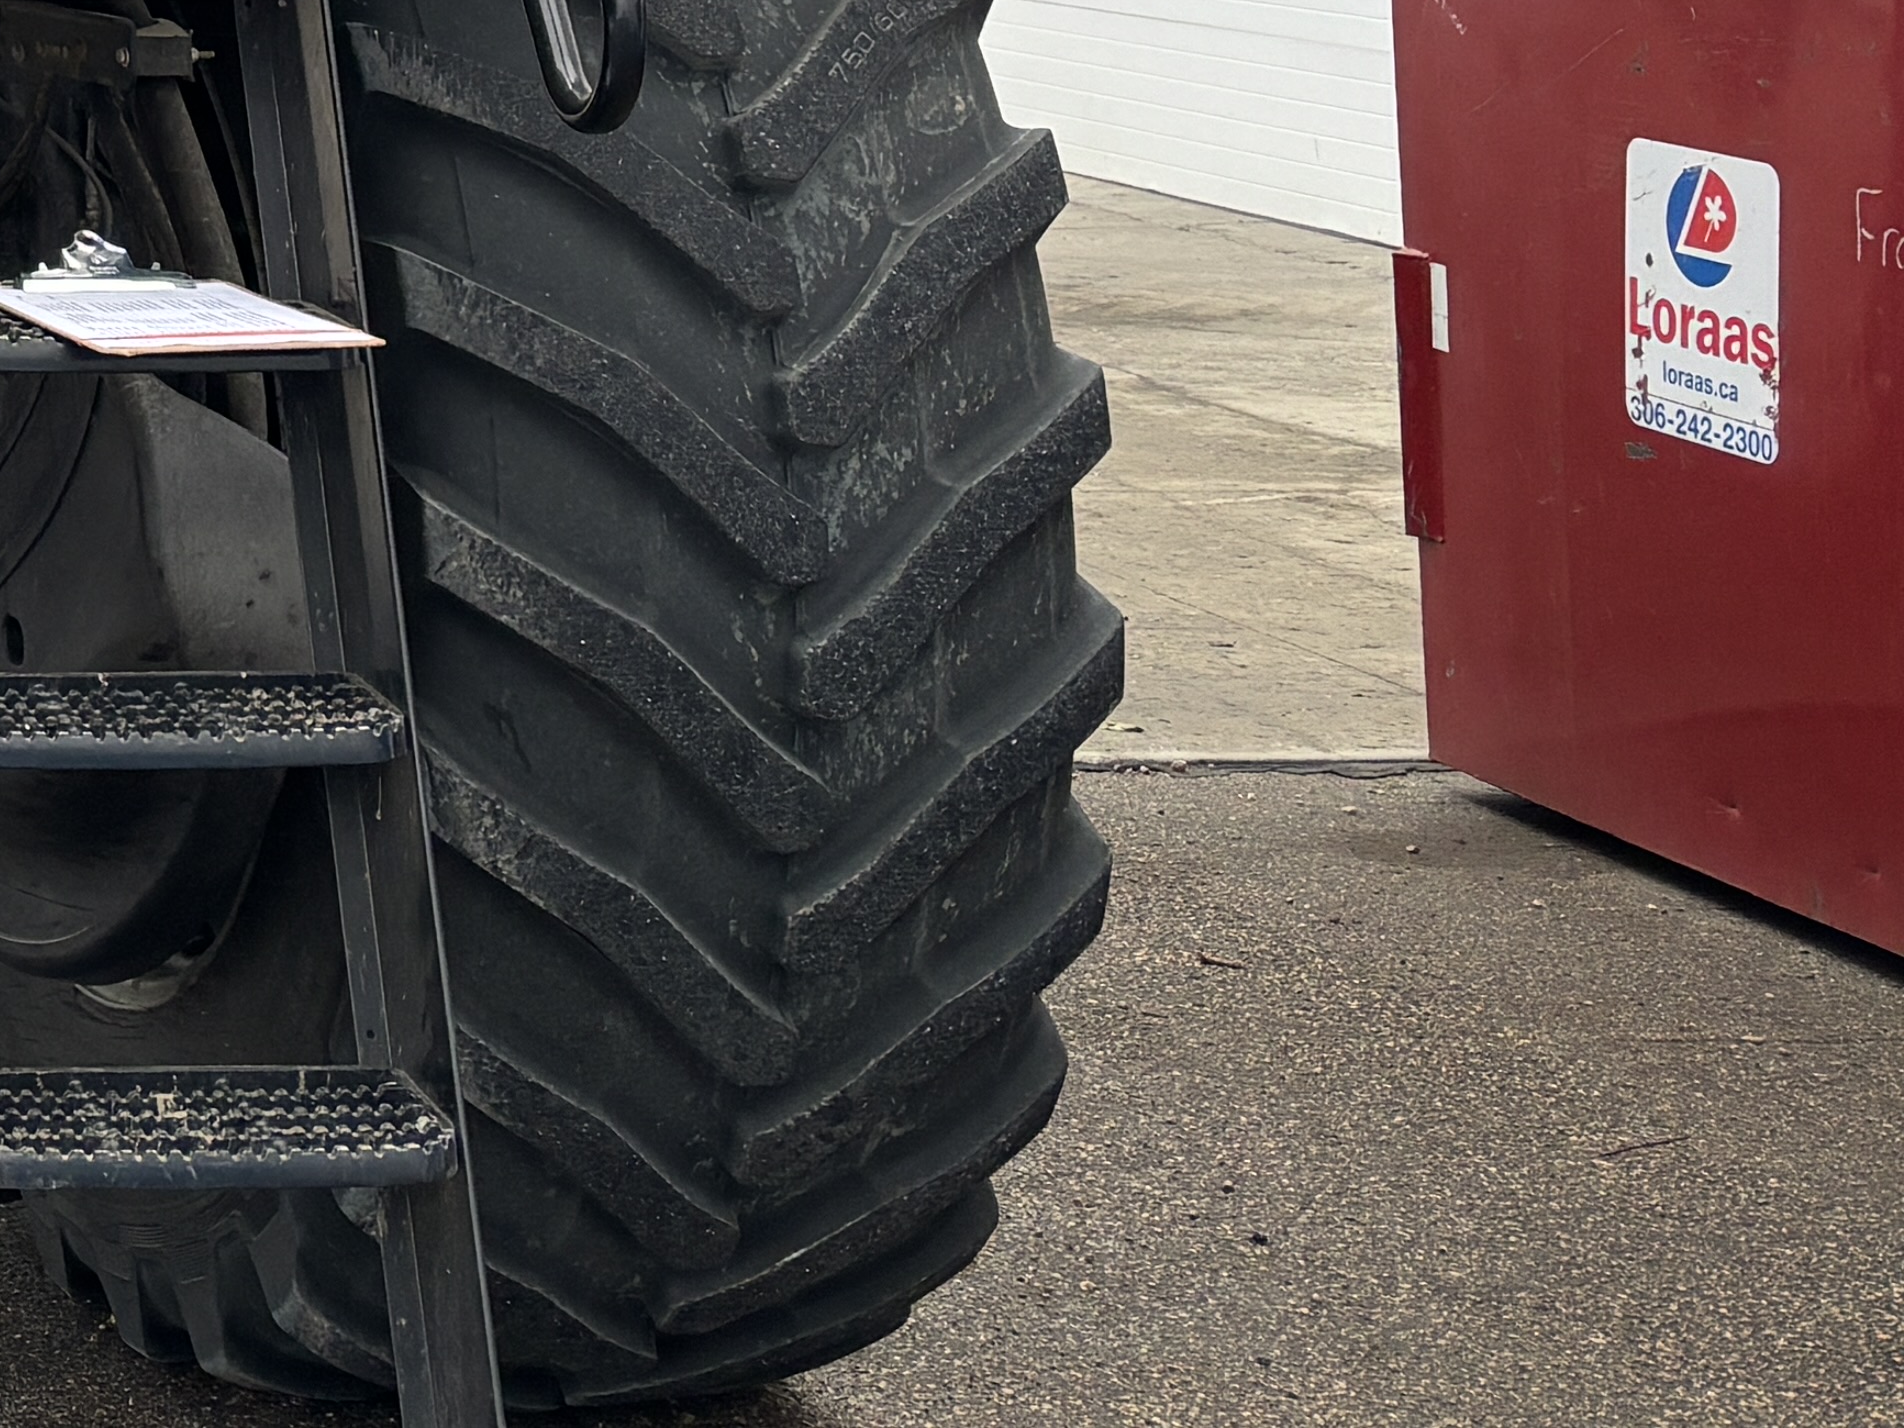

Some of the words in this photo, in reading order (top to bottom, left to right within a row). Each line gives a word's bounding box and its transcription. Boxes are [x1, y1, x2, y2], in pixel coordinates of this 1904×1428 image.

[1629, 276, 1776, 369] Loraas
[1663, 361, 1739, 402] loraas.ca
[1631, 397, 1773, 461] 306-242-2300
